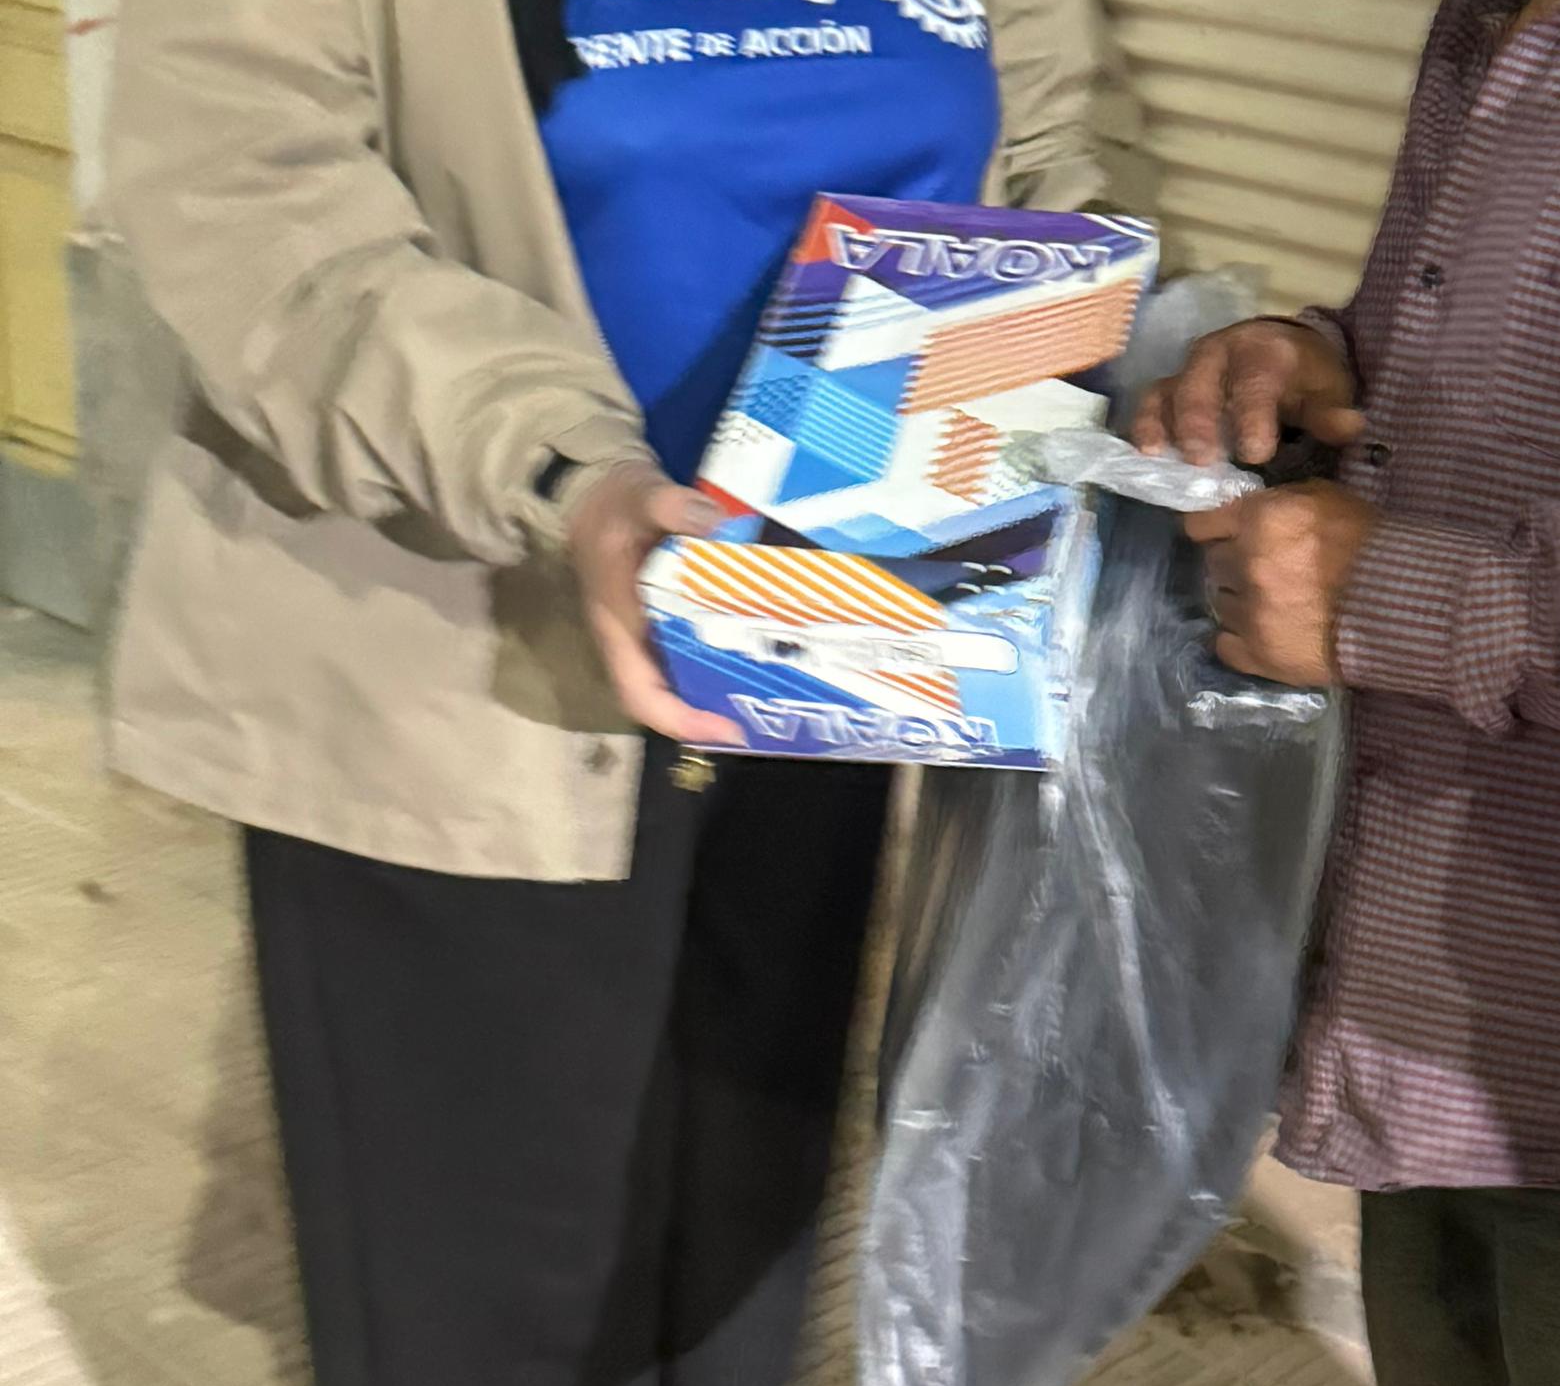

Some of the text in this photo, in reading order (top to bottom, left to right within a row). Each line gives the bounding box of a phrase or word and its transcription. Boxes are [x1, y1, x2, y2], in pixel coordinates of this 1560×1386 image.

[694, 31, 736, 57] DE
[740, 19, 872, 59] ACCIÓN
[826, 222, 1112, 285] KOALA
